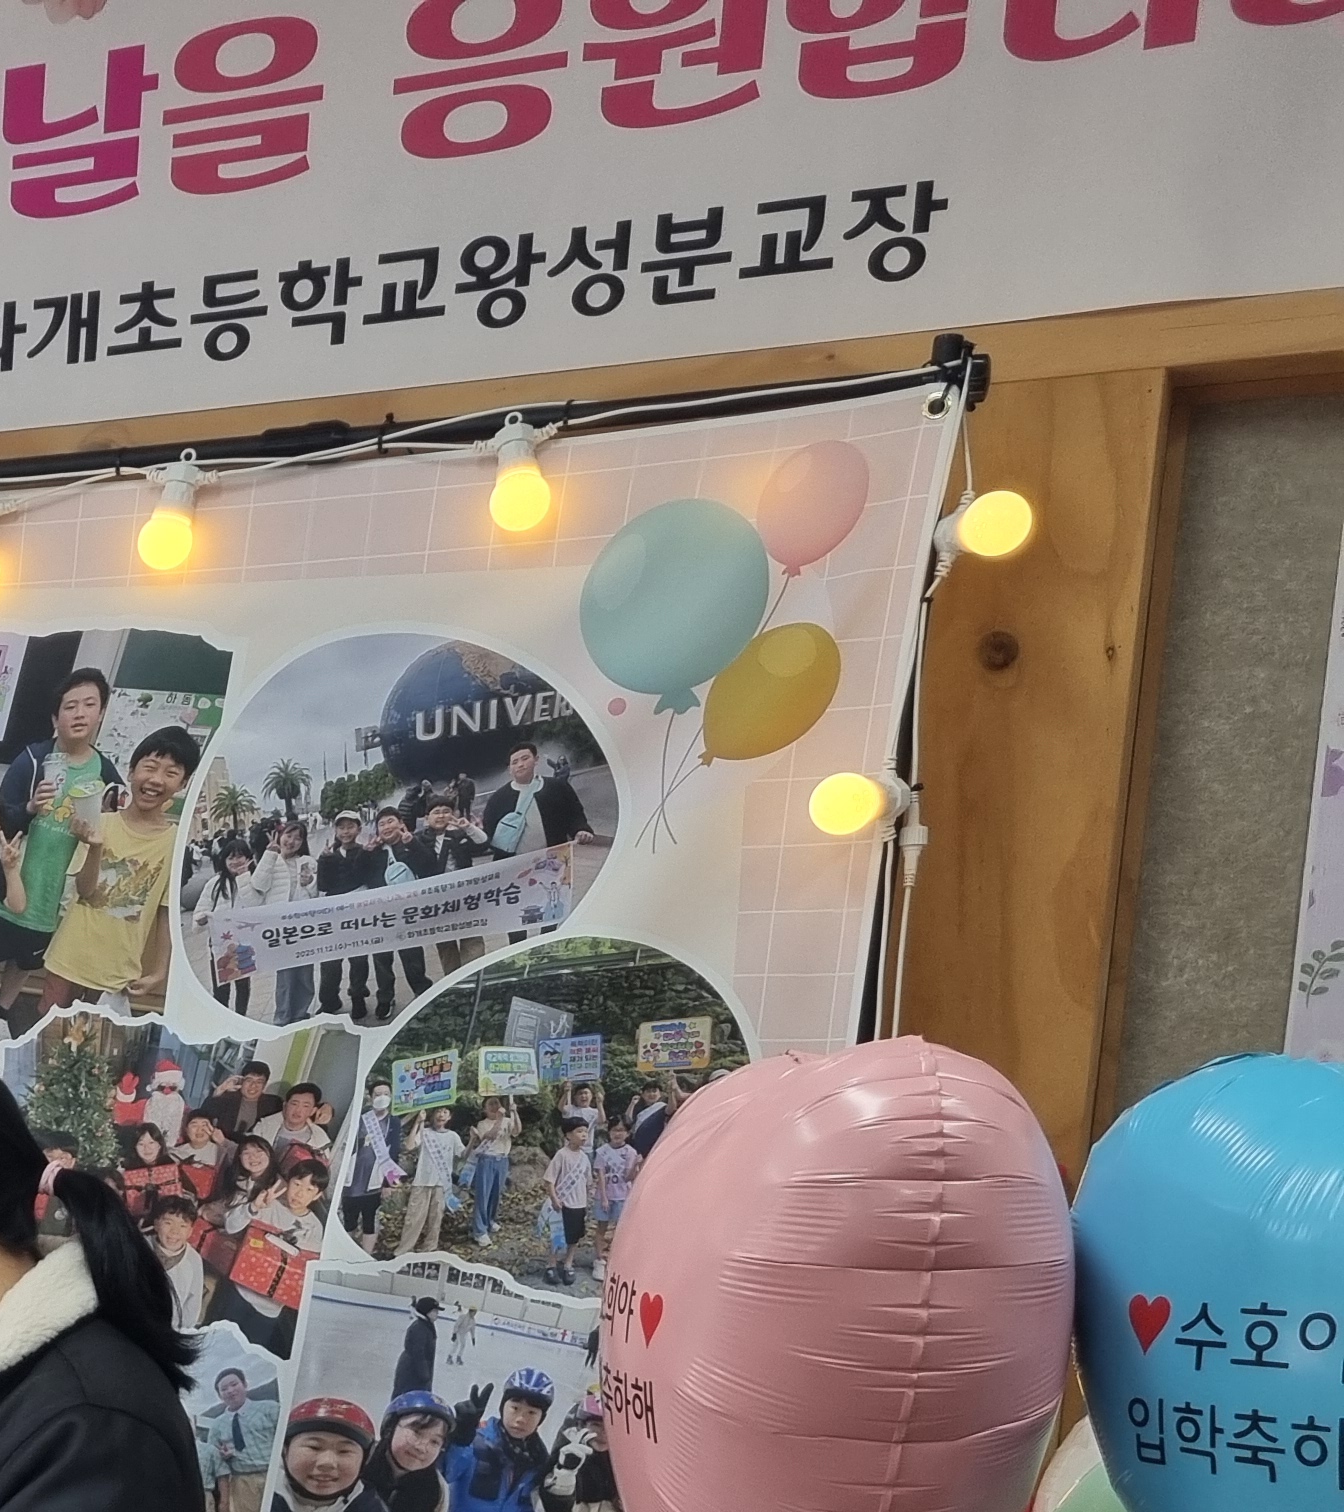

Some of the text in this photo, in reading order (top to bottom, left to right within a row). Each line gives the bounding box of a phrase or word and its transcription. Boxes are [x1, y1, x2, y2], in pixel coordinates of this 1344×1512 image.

[393, 0, 1344, 159] 응원합
[261, 921, 334, 949] 일본으로
[340, 912, 397, 931] 떠나는
[401, 882, 522, 925] 문화체험학습
[604, 1271, 637, 1344] 희야
